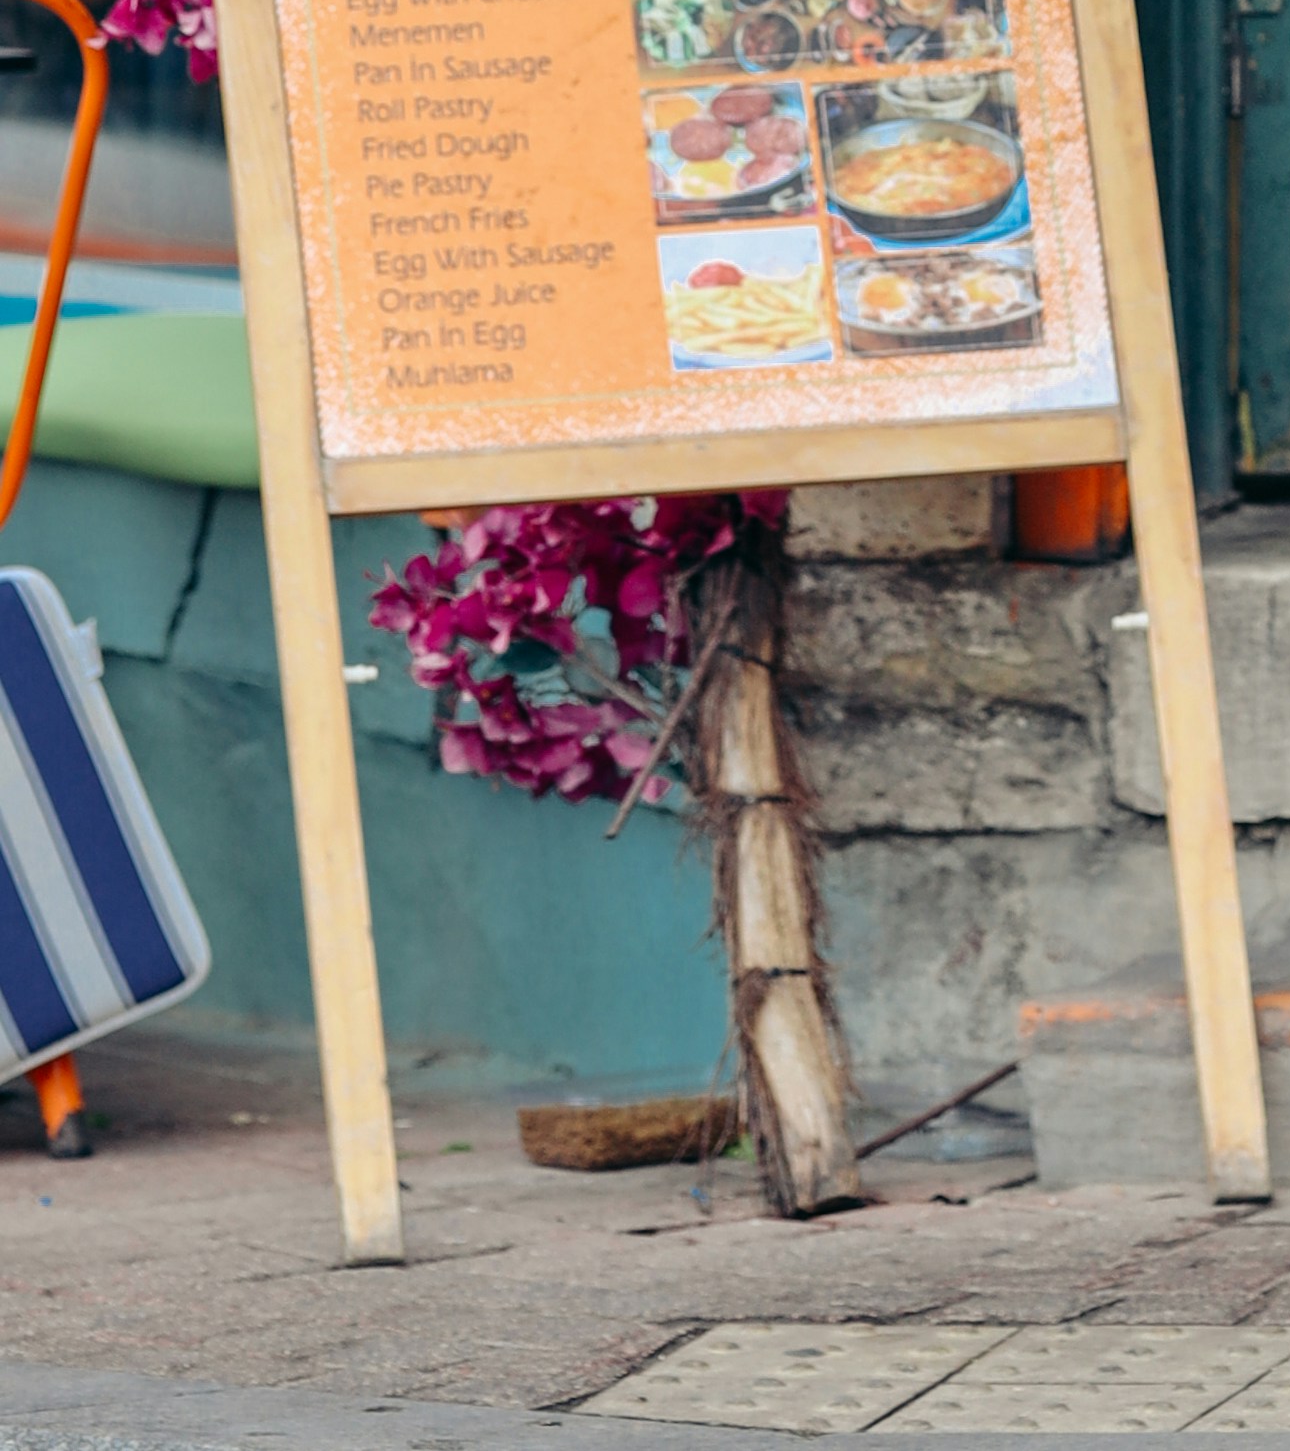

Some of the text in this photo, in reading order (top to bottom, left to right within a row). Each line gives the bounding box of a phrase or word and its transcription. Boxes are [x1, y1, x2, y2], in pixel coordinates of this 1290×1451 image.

[349, 20, 484, 48] Menemen
[353, 61, 402, 85] Pan
[443, 55, 552, 83] Sausage
[357, 96, 493, 124] Roll Pastry
[361, 130, 529, 160] Fried Dough
[365, 172, 492, 199] Pie Pastry
[369, 206, 529, 236] French Fries
[374, 241, 616, 280] Egg With Sausage
[377, 282, 557, 315] Orange Juice
[382, 326, 431, 351] Pan
[472, 320, 526, 351] Egg
[386, 362, 514, 389] Muhlama
